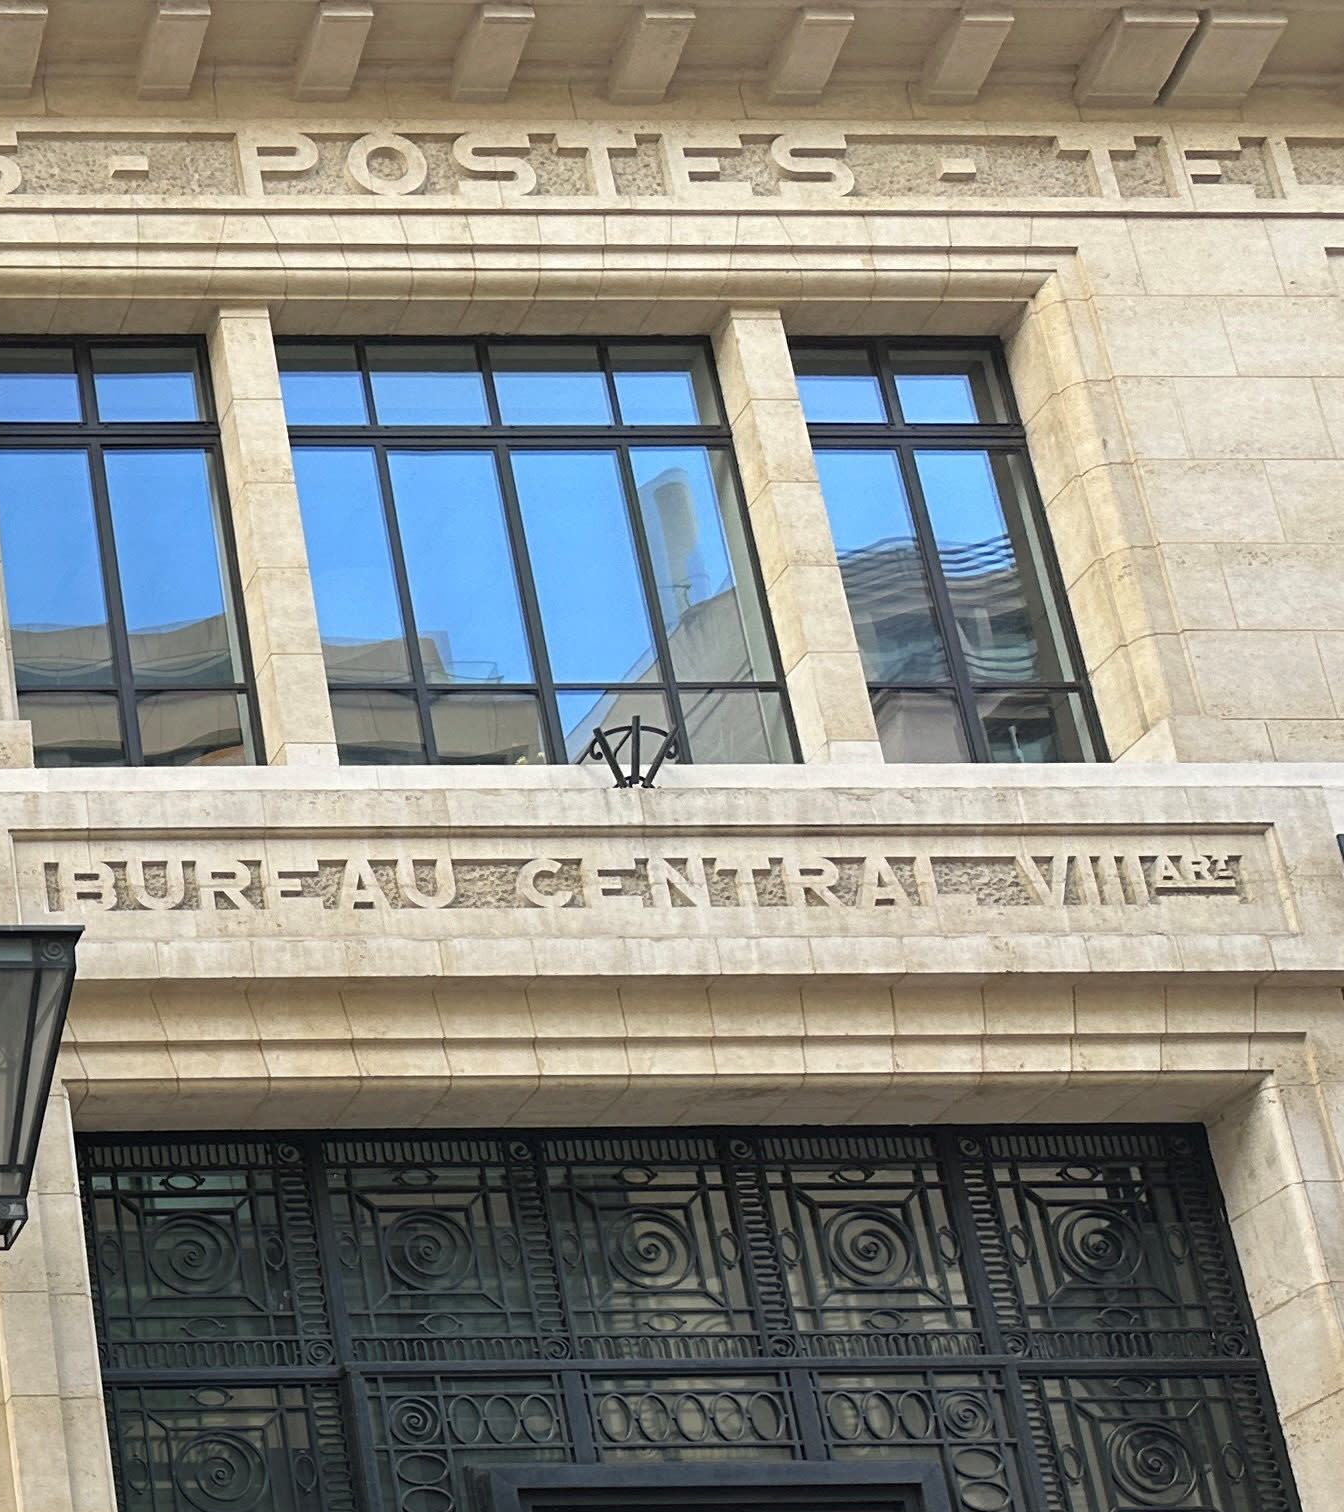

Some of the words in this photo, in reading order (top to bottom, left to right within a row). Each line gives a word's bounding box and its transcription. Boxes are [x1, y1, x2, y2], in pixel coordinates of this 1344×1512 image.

[237, 132, 855, 198] POSTES
[58, 858, 458, 912] BUREAU
[515, 856, 978, 909] CENTRAL
